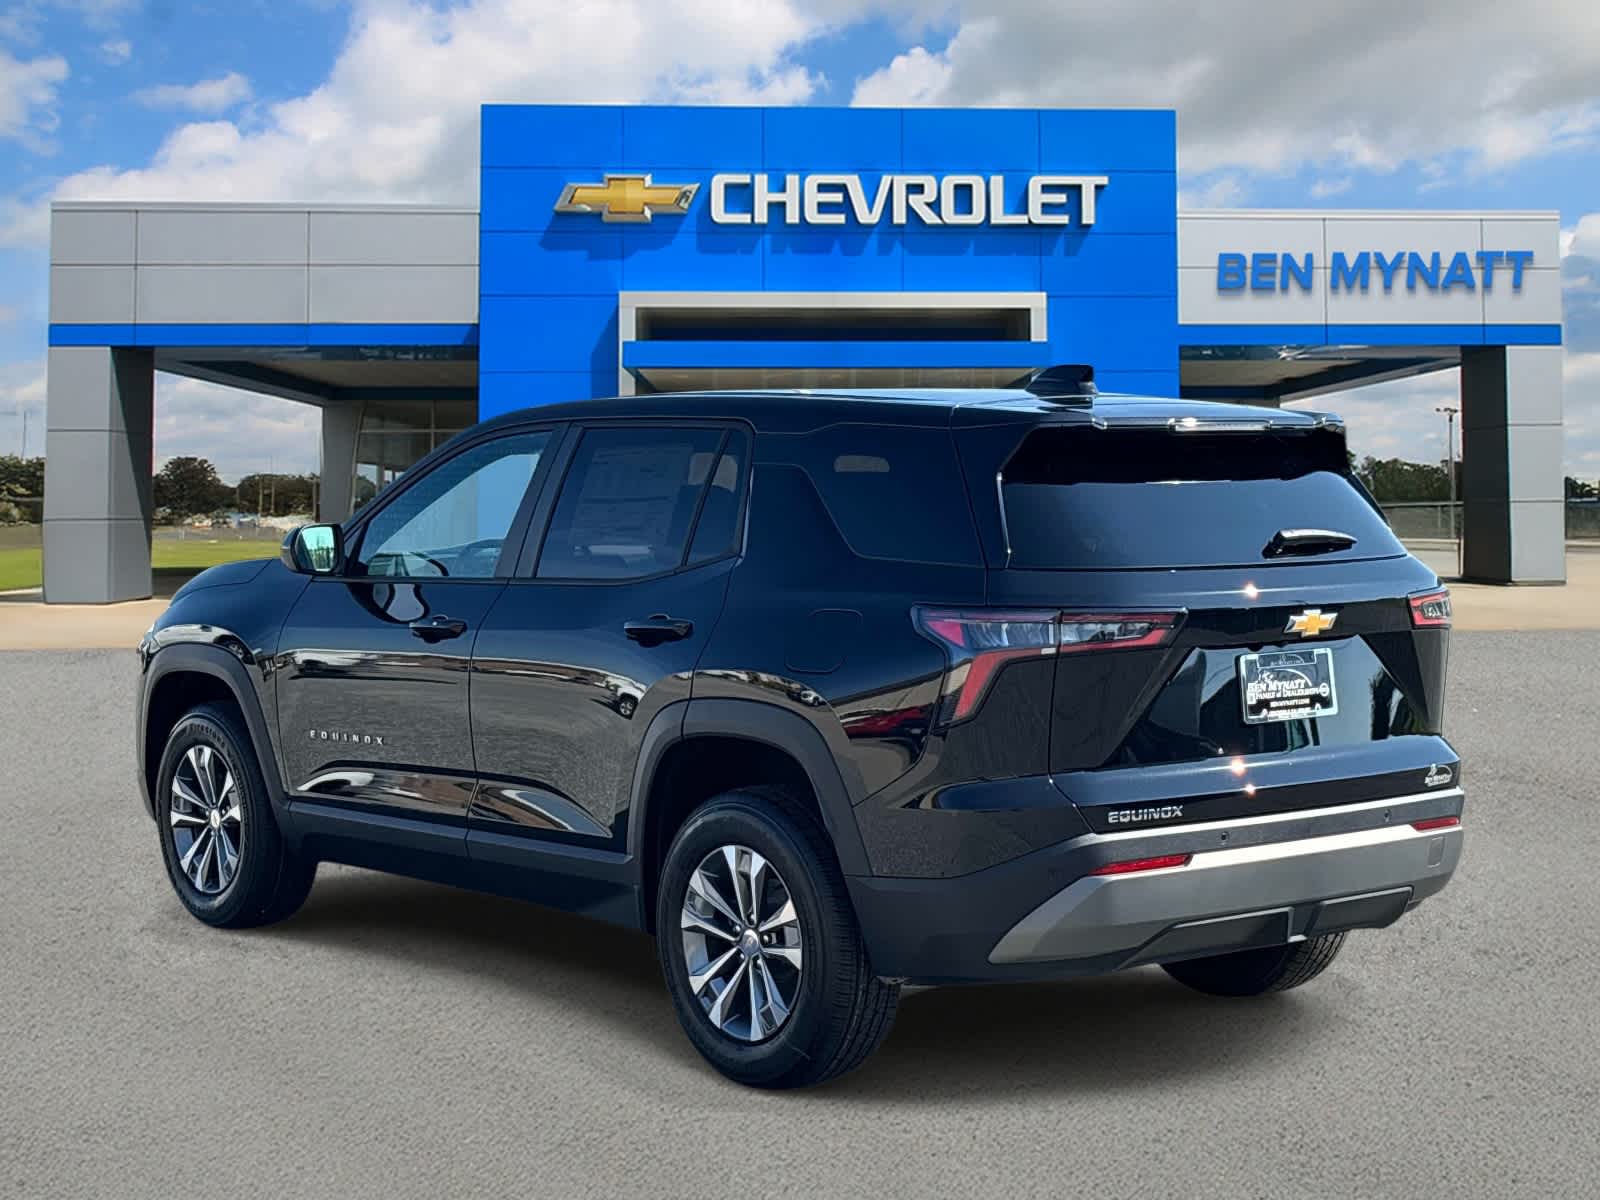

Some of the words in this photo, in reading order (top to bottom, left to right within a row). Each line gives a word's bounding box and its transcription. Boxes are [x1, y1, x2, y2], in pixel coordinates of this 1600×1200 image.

[710, 173, 1110, 226] CHEVROLET
[1217, 252, 1313, 291] BEN
[1330, 250, 1534, 291] MYNATT
[310, 729, 384, 745] EQUINOX
[1107, 804, 1184, 824] EQUINOX
